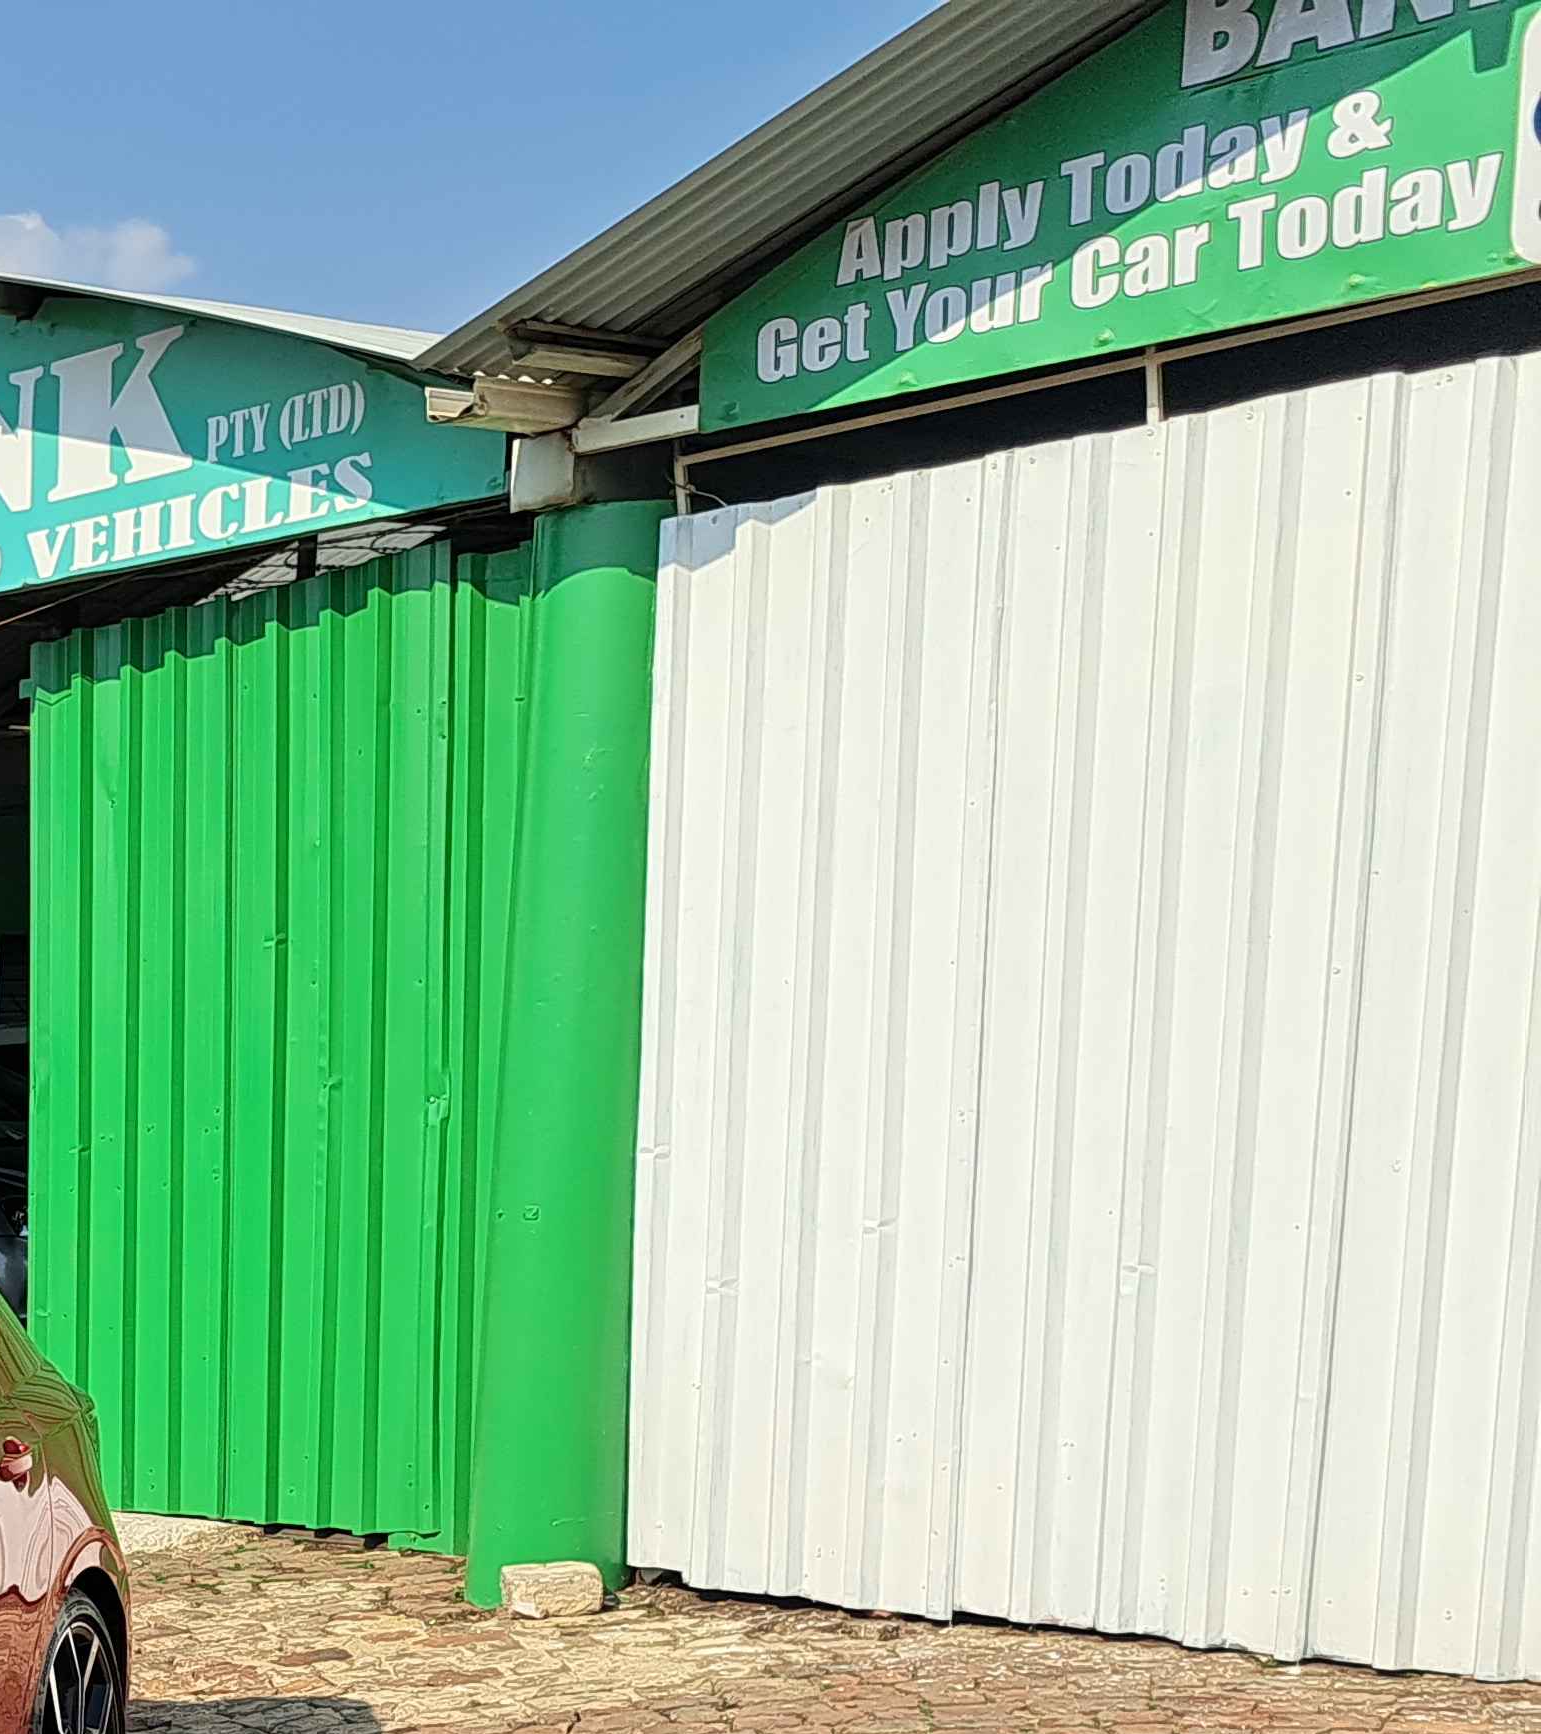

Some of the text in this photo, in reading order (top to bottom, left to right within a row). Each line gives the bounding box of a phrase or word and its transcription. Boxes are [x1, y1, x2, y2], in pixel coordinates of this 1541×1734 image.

[1180, 0, 1500, 89] BA
[837, 90, 1393, 286] Apply Today &
[757, 154, 1503, 384] Get Your Car Today
[207, 403, 271, 463] PTY
[280, 381, 365, 450] (LTD)
[26, 451, 374, 579] VEHICLES
